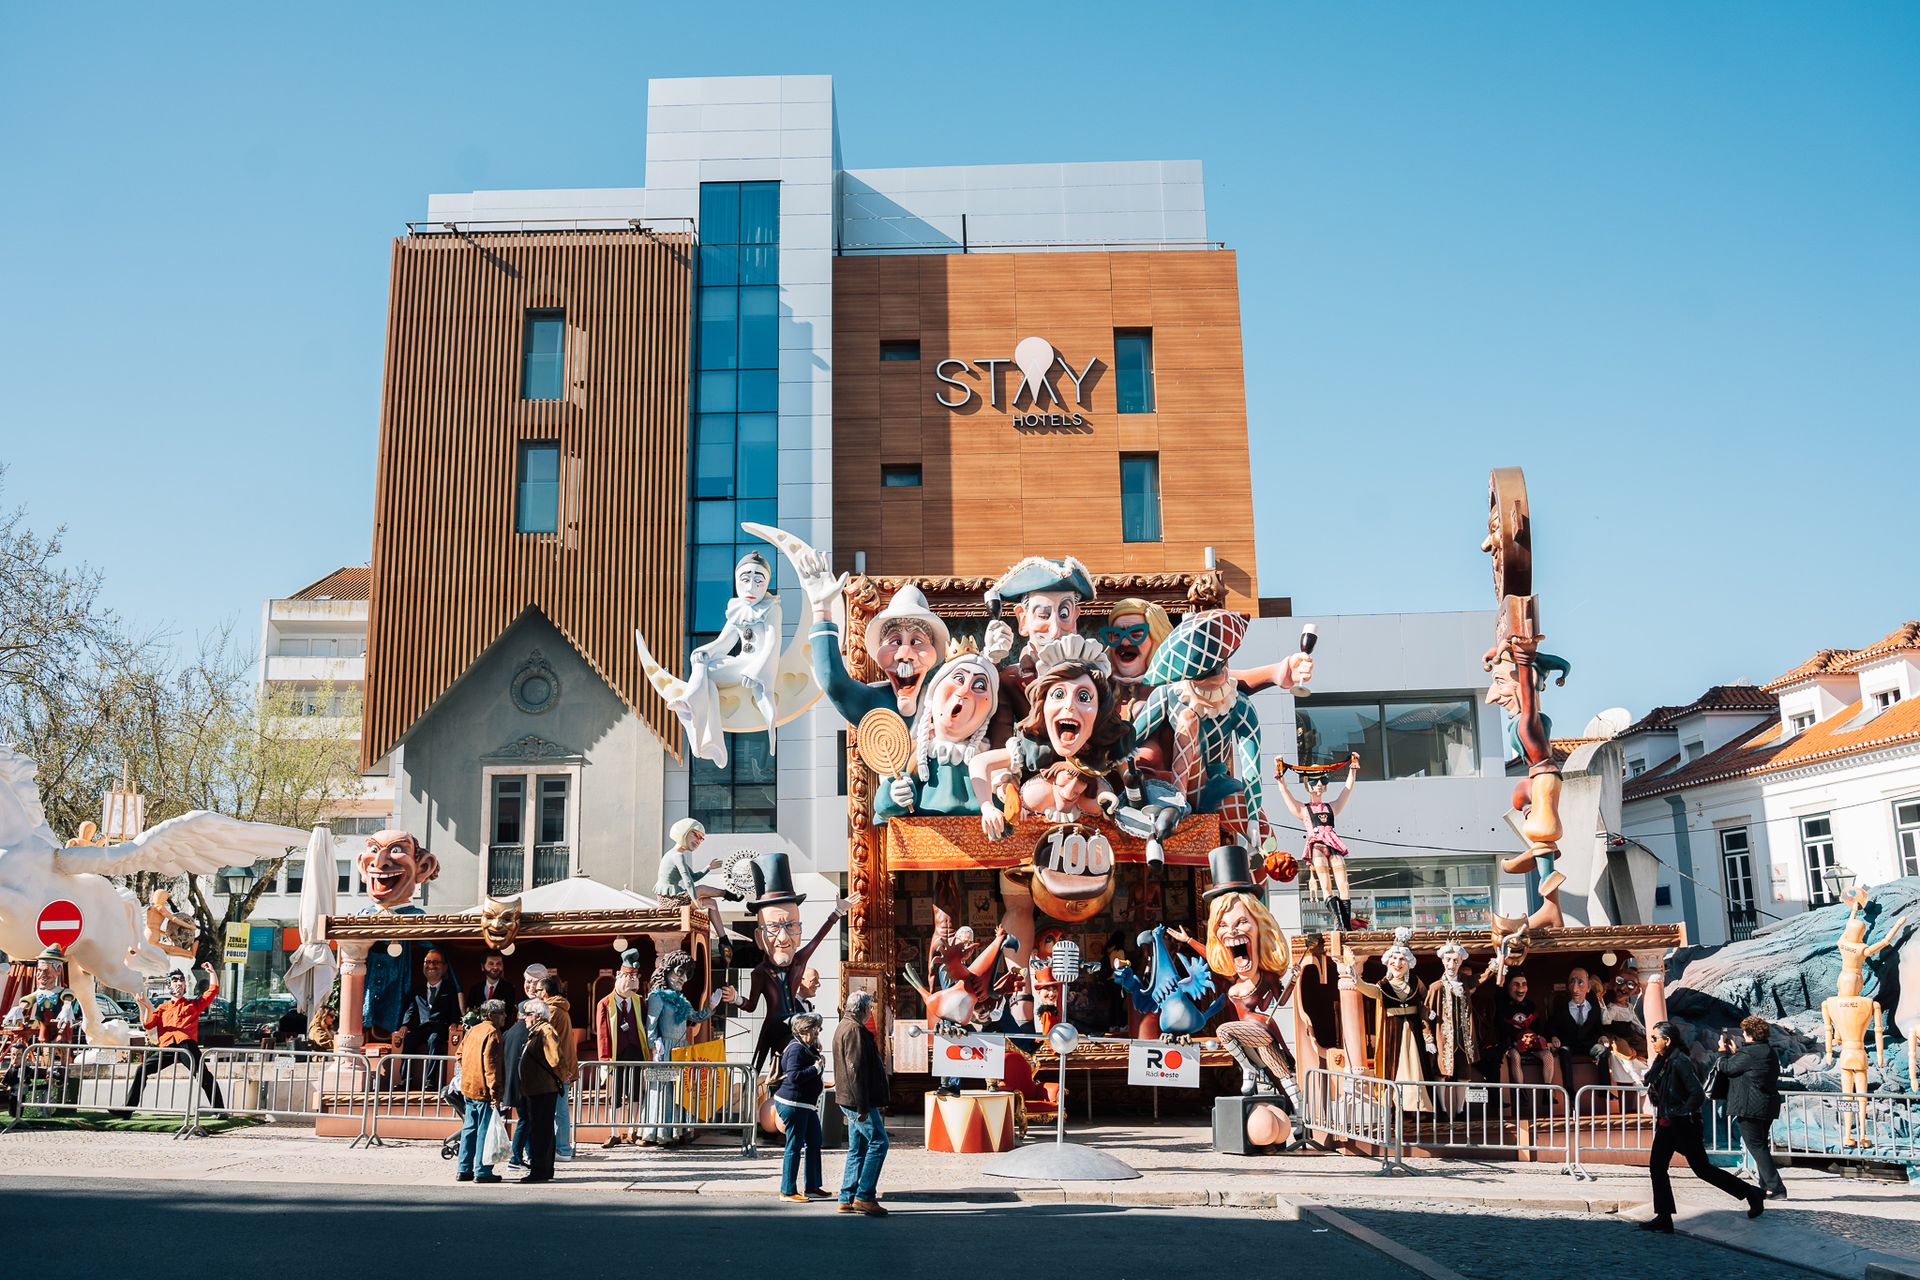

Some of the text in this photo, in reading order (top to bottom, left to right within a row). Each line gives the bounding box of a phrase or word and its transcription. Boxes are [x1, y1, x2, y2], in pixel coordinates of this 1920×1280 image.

[935, 355, 1098, 407] STAY
[1012, 413, 1083, 428] HOTELS
[1047, 831, 1112, 875] 100
